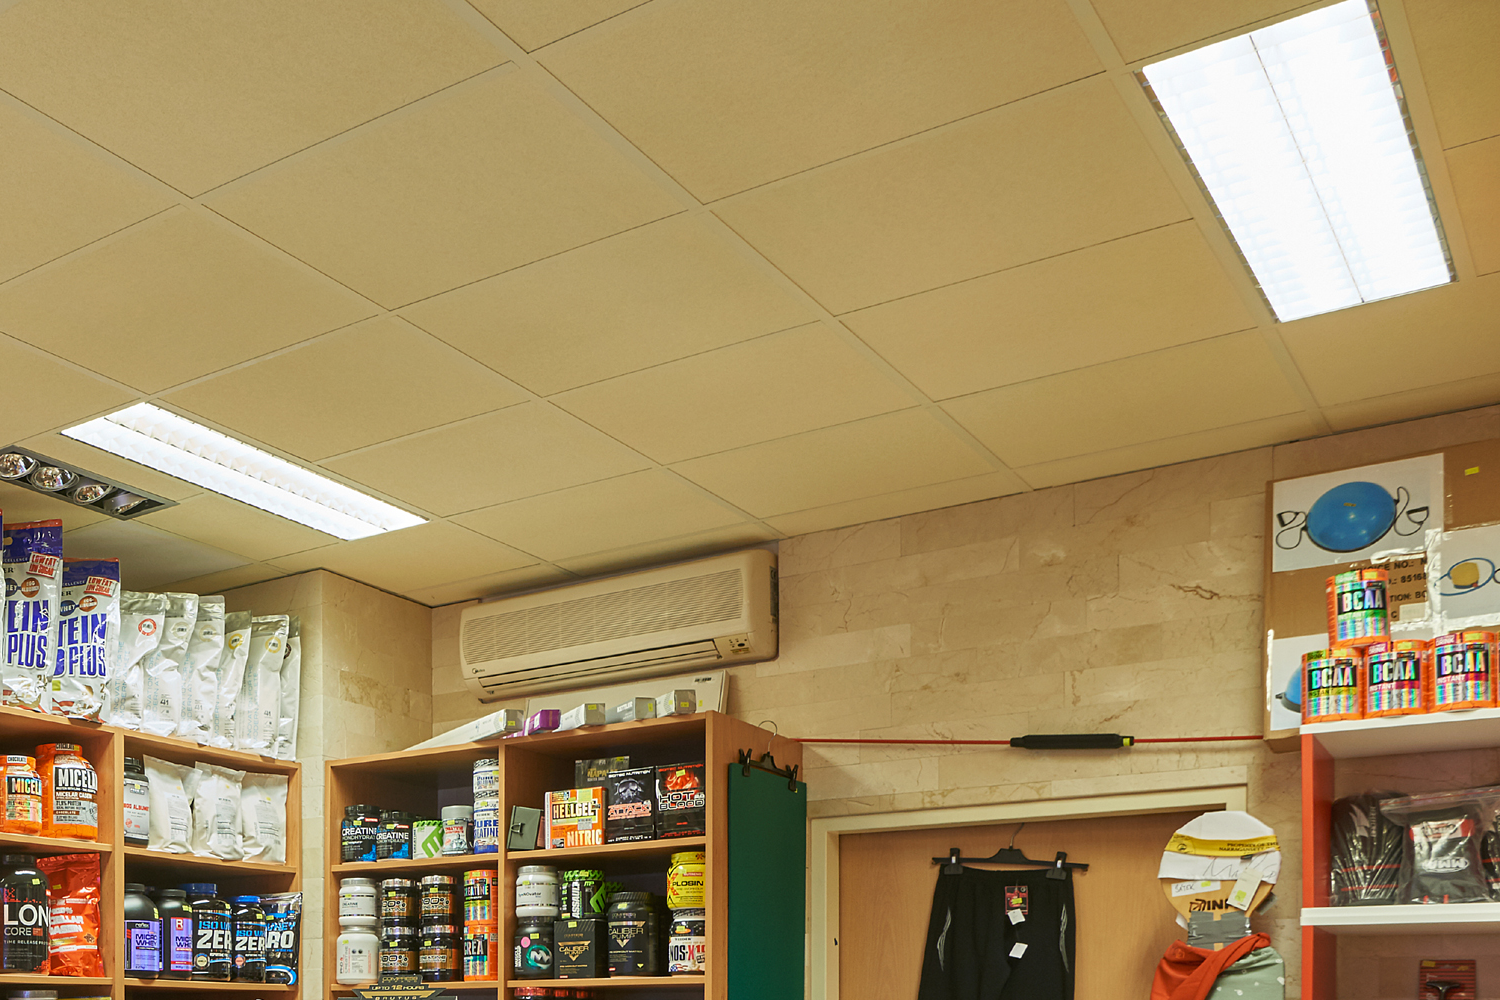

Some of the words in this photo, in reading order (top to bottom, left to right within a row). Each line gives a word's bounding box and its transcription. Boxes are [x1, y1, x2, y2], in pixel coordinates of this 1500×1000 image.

[1343, 589, 1383, 612] BCAA
[8, 634, 46, 669] PLUS
[68, 644, 106, 677] PLUS
[1372, 661, 1416, 683] BCAA
[1440, 651, 1489, 675] BCAA
[1311, 665, 1354, 689] BCAA
[1437, 674, 1465, 684] INSTANT
[553, 802, 594, 819] HELLGEL
[660, 800, 704, 810] BLOOD
[567, 829, 602, 847] NITRIC
[4, 928, 31, 936] CORE
